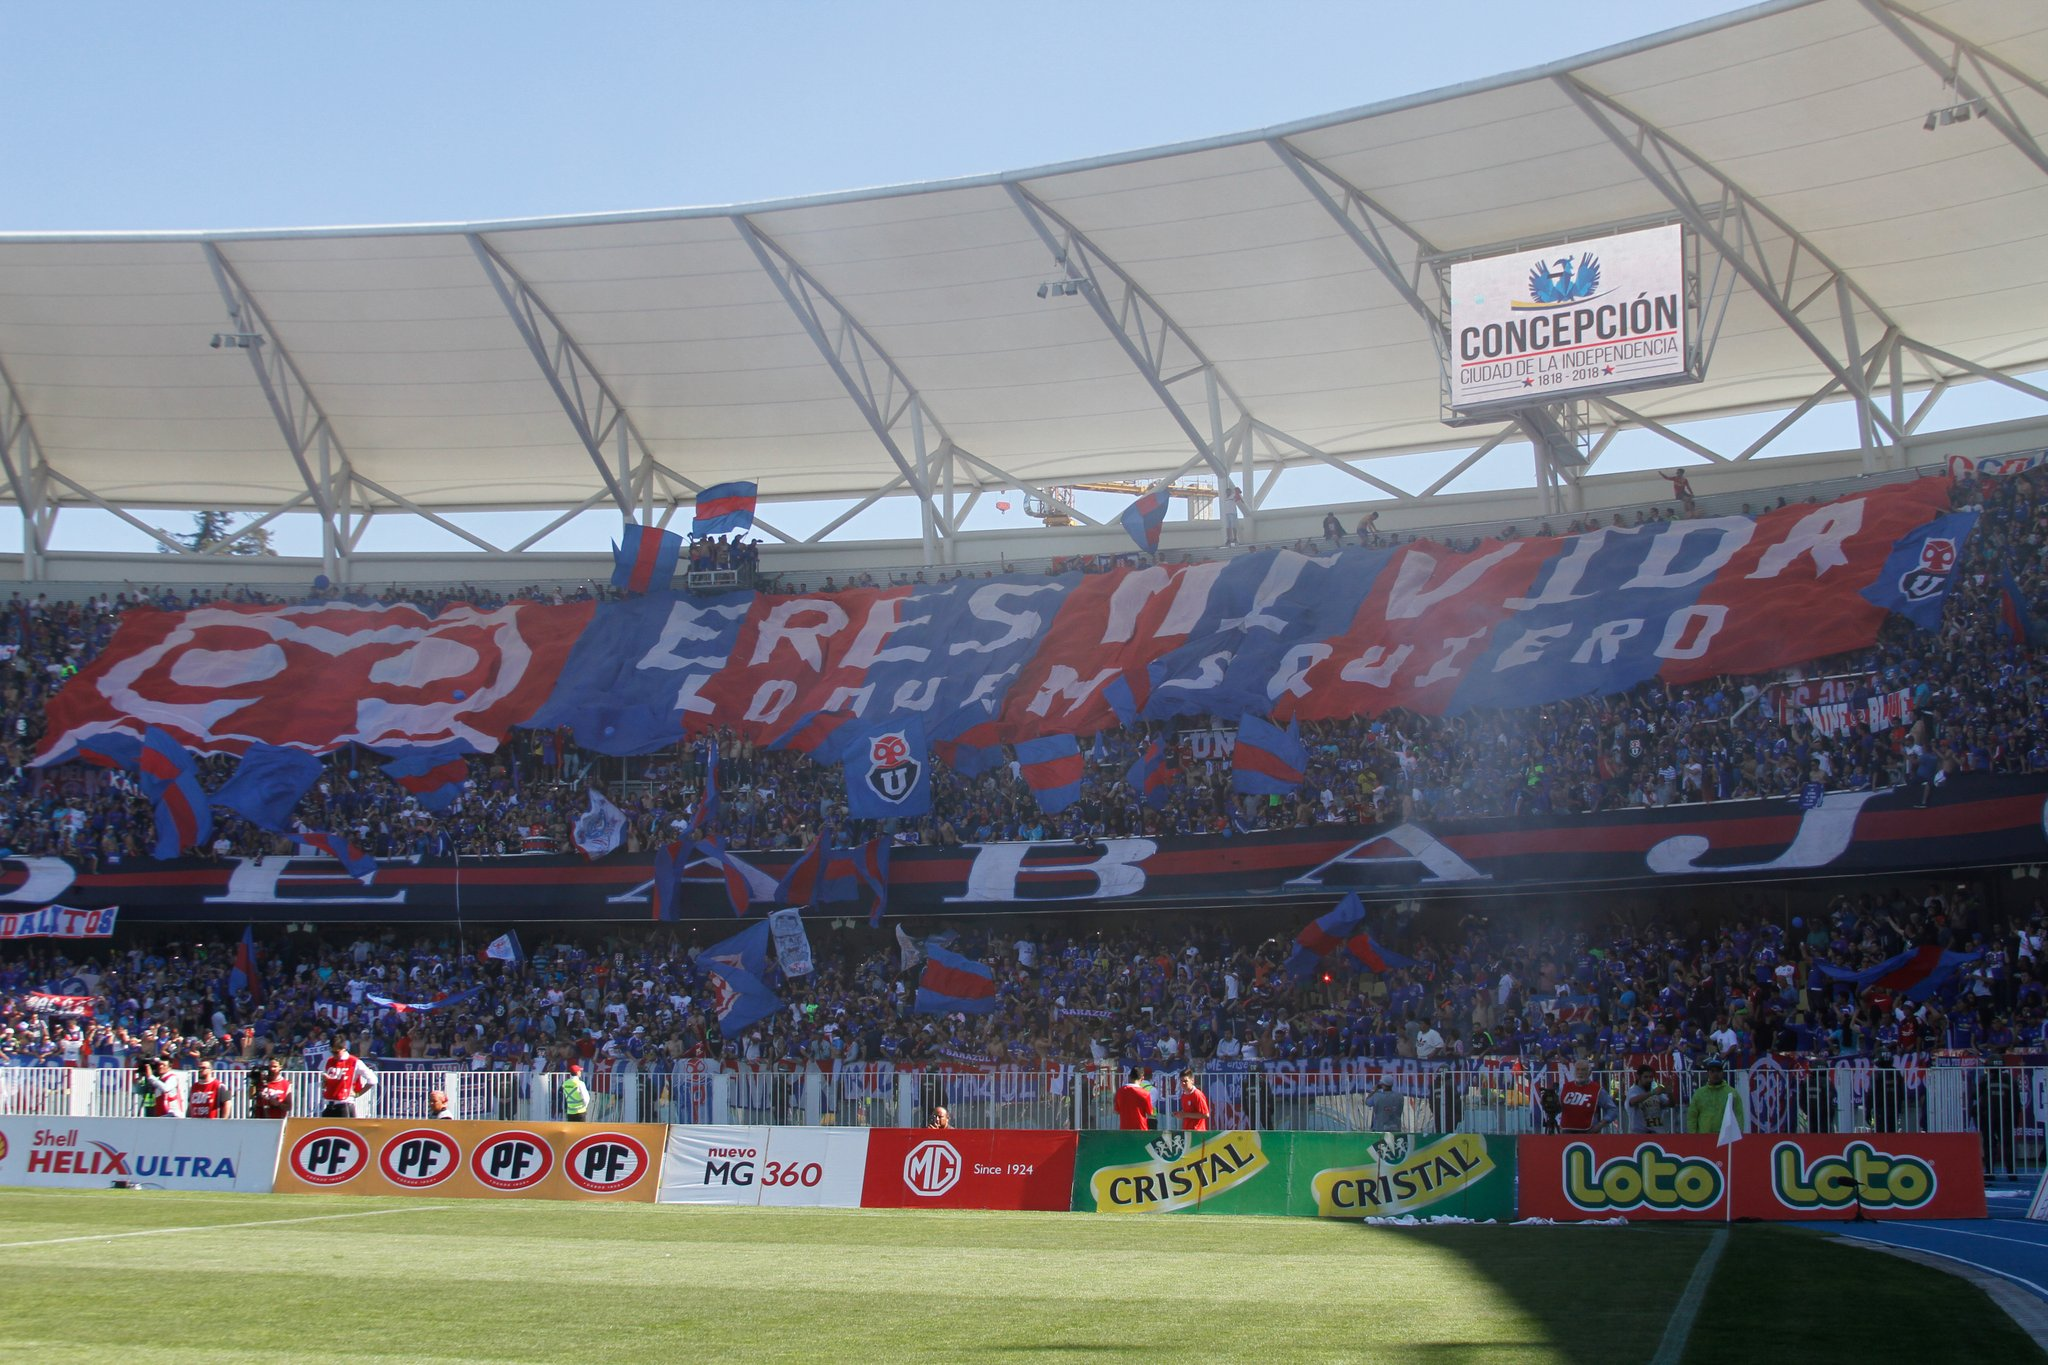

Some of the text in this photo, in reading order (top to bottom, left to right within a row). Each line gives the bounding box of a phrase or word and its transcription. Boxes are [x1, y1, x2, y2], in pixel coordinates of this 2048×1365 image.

[1460, 291, 1678, 361] CONCEPCIÓN
[1460, 336, 1678, 385] CIUDAD DE LA INDEPENDENCIA
[1538, 374, 1562, 386] 1818
[1573, 367, 1599, 382] 2018
[636, 583, 1064, 673] ERES
[675, 674, 797, 724] LO
[1026, 650, 1238, 717] MS
[1267, 605, 1729, 699] QUIERO
[881, 767, 907, 796] U
[0, 905, 114, 935] DALITOS
[1563, 1091, 1591, 1107] CDF.
[33, 1129, 78, 1147] Shell
[308, 1138, 350, 1174] PF
[708, 1148, 757, 1158] nuevo
[27, 1149, 236, 1178] HELIX ULTRA
[398, 1140, 442, 1177] PF
[490, 1142, 534, 1179] PF
[584, 1144, 629, 1181] PF
[704, 1161, 822, 1187] MG 360
[910, 1147, 955, 1190] MG
[973, 1163, 1034, 1175] Since 1924
[1109, 1143, 1255, 1204] CRISTAL
[1567, 1146, 1719, 1207] Loto
[1778, 1145, 1932, 1205] Loto
[1331, 1146, 1480, 1209] CRISTAL
